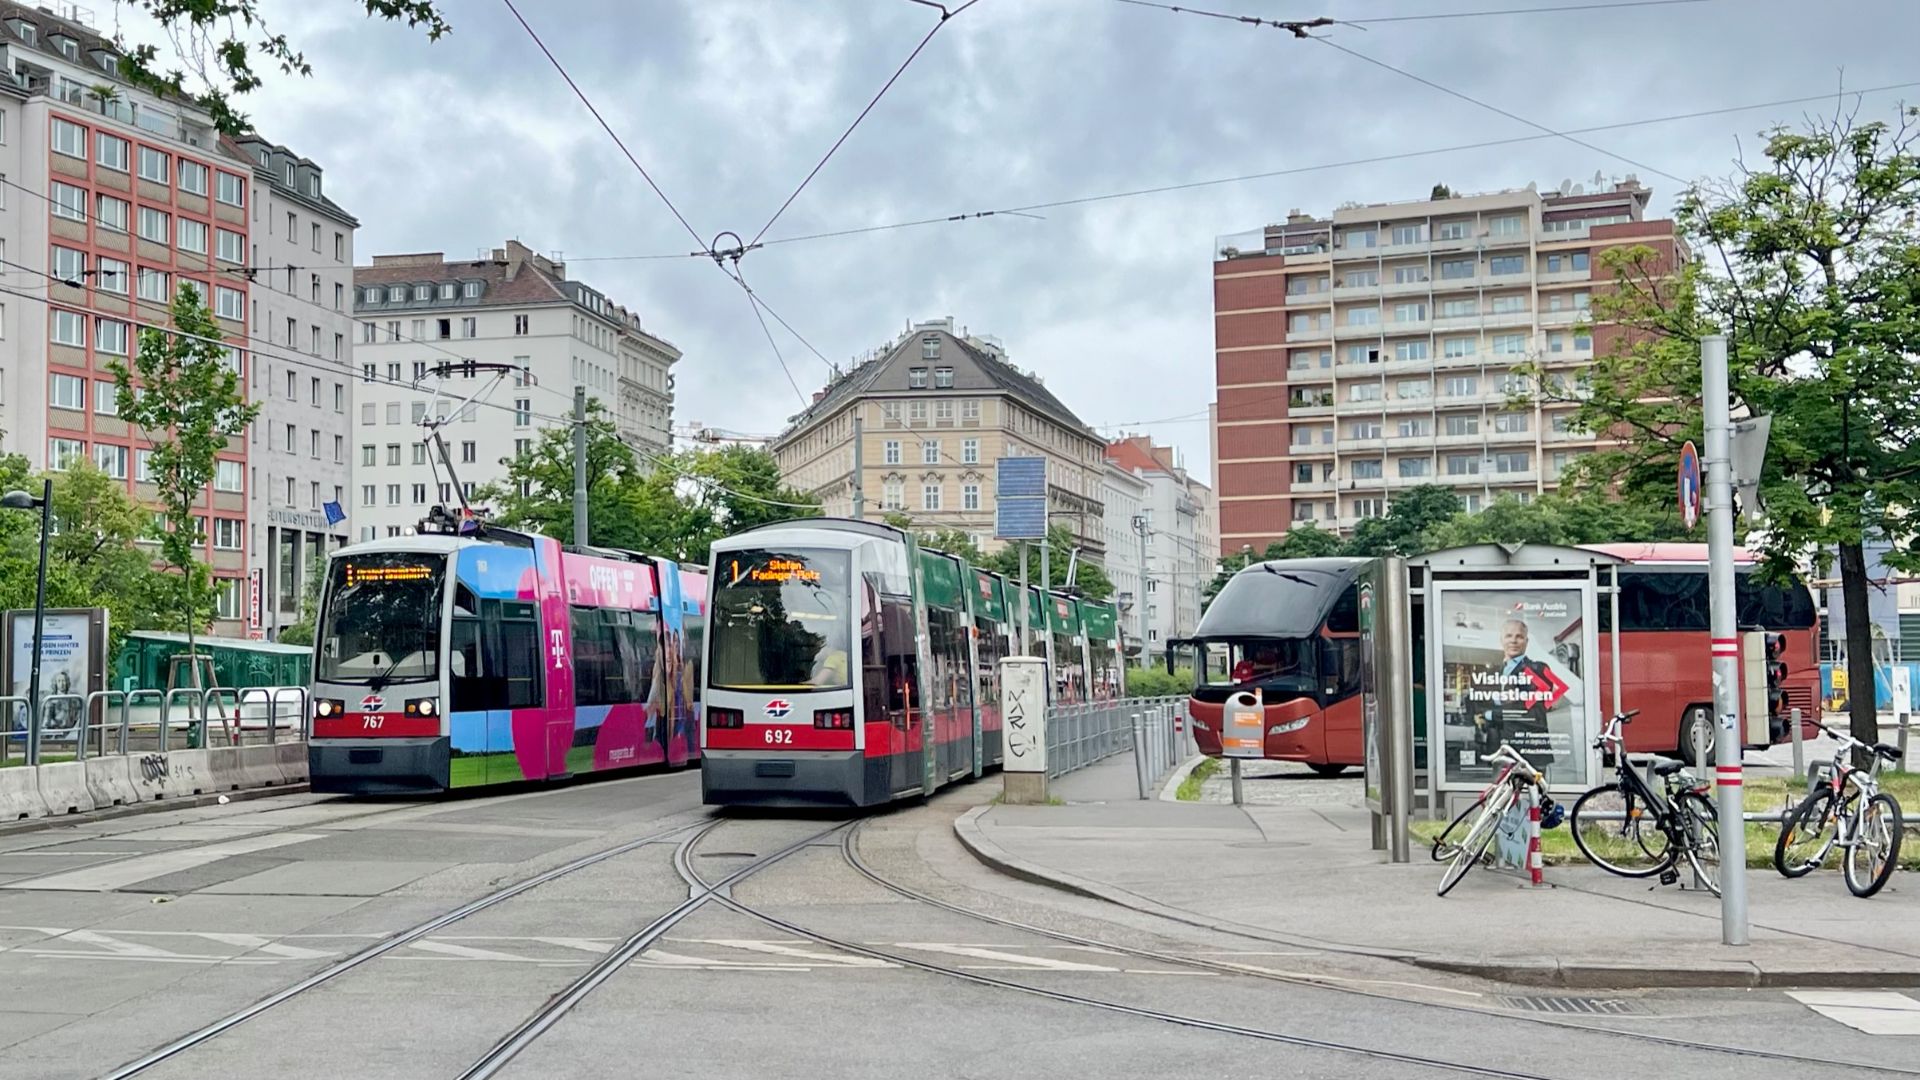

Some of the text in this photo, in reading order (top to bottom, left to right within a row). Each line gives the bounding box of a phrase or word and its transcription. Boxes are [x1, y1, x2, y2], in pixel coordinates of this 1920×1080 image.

[590, 564, 618, 592] OFFEN
[732, 560, 738, 582] 1
[752, 570, 821, 581] Fadinger-Platz
[1472, 671, 1533, 685] Visionär
[1469, 687, 1554, 701] investieren
[363, 716, 385, 729] 767
[765, 729, 793, 744] 692
